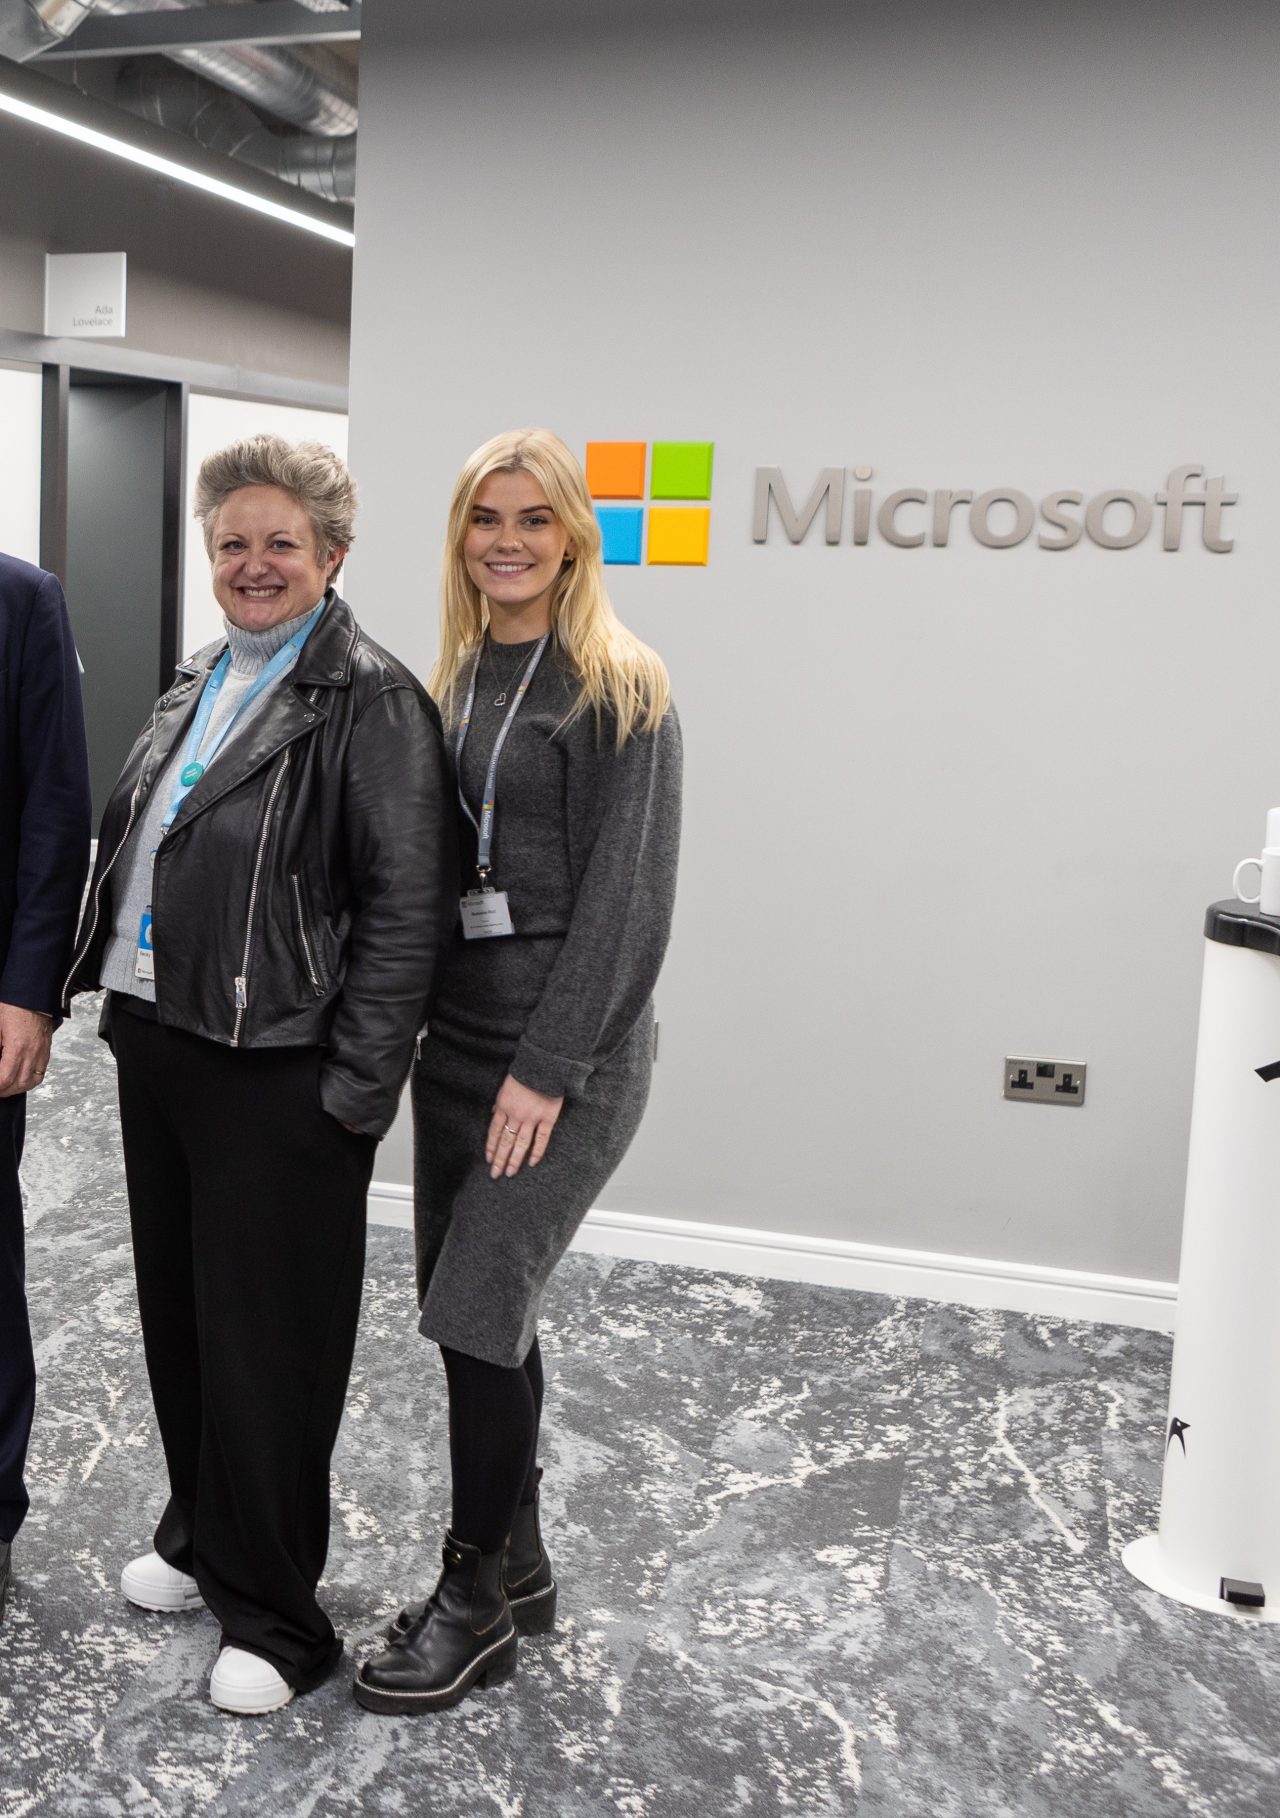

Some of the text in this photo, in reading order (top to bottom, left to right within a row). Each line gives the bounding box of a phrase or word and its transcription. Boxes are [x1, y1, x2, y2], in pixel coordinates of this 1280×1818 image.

[95, 305, 113, 314] Ada
[72, 317, 113, 327] Lovelace
[752, 464, 1238, 553] Microsoft
[481, 810, 492, 839] Microsoft
